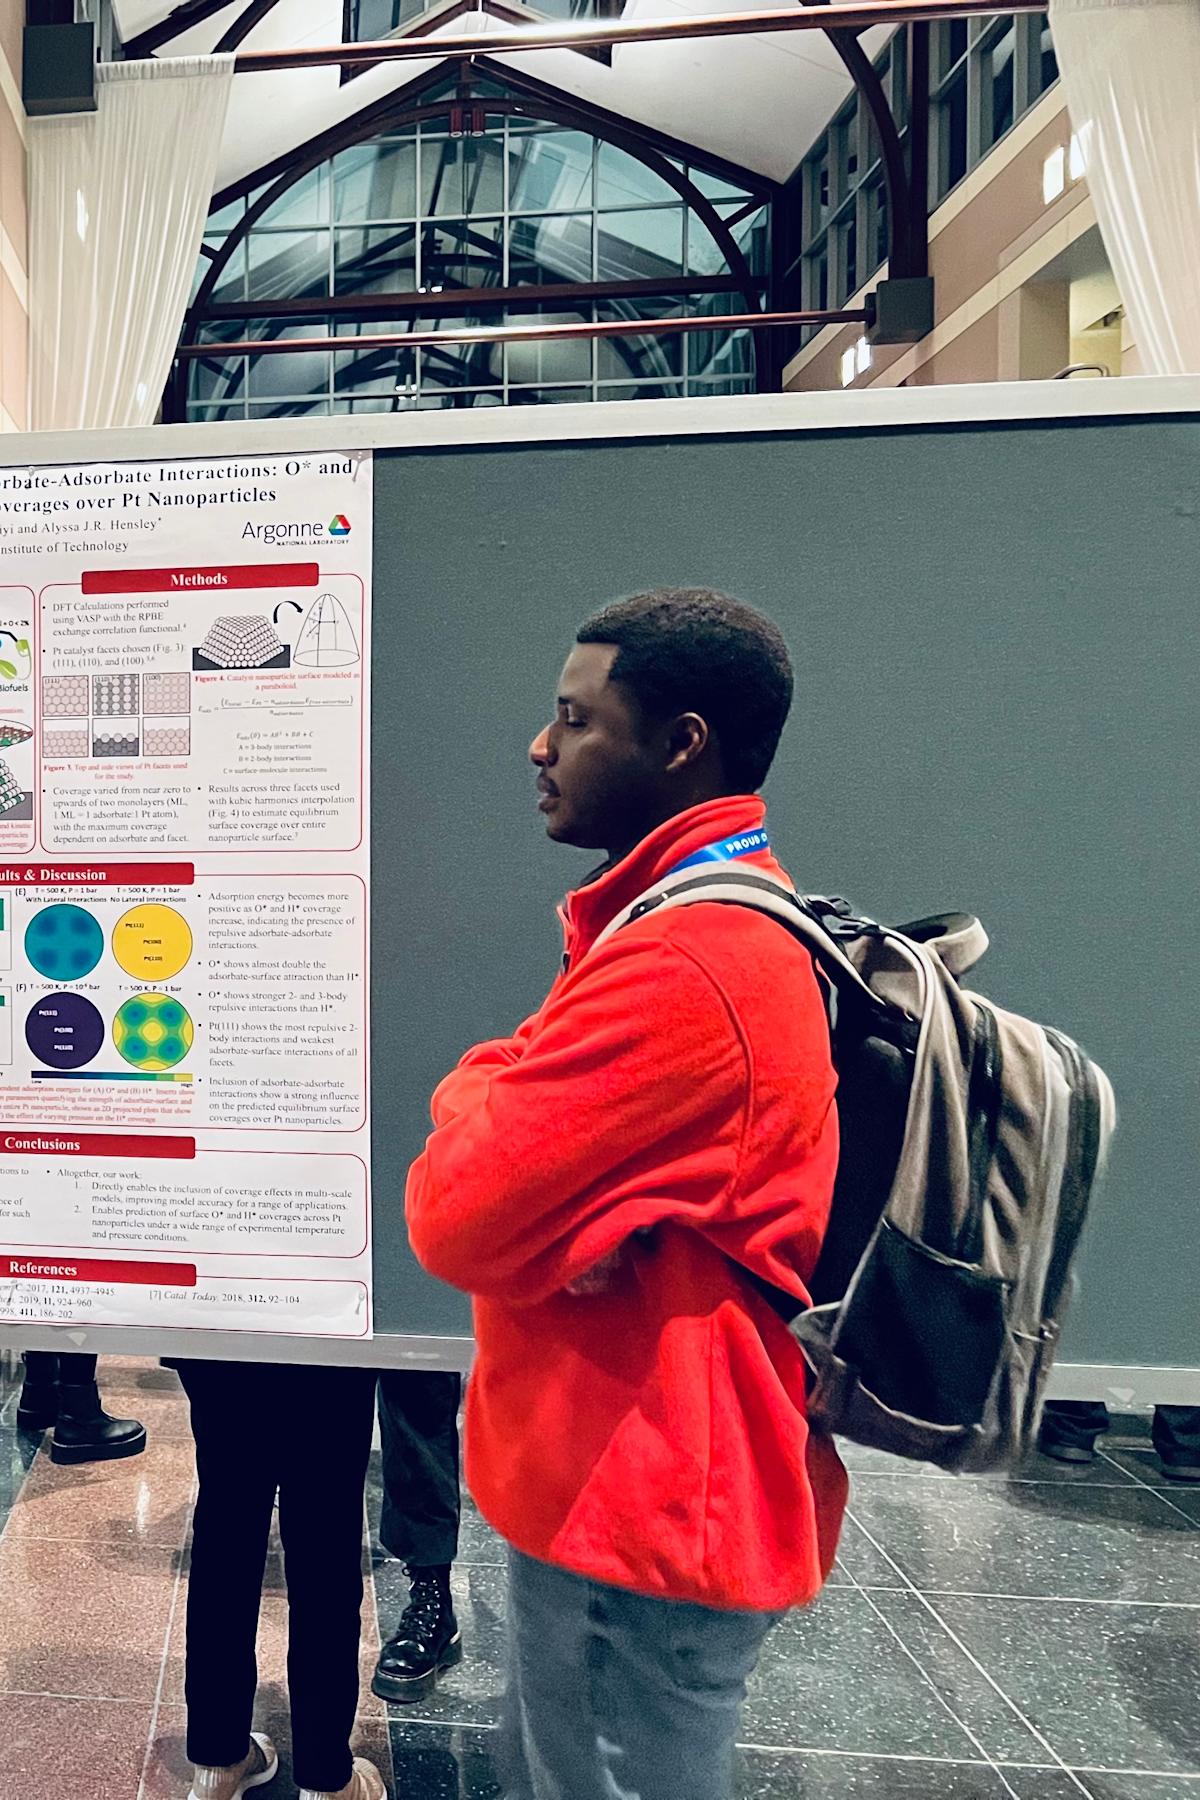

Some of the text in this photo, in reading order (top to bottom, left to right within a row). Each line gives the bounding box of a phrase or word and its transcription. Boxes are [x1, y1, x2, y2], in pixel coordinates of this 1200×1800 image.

[159, 464, 276, 481] Interactions:
[318, 458, 354, 474] and
[76, 497, 115, 510] over
[122, 492, 141, 507] Pt
[147, 486, 276, 508] Nanoparticles
[17, 522, 37, 534] and
[41, 521, 79, 535] Alyssa
[241, 521, 323, 544] Argonne
[46, 541, 60, 552] of
[62, 540, 128, 553] Technology
[170, 572, 228, 586] Methods
[52, 599, 169, 612] DFT Calculations performed
[52, 611, 163, 626] using VASP with the RPBE
[208, 783, 239, 793] Results
[269, 783, 291, 792] three
[293, 782, 318, 792] facets
[320, 782, 340, 791] used
[725, 834, 760, 853] PROUD
[23, 868, 36, 881] &
[39, 868, 106, 881] Discussion
[14, 887, 26, 897] (E)
[208, 891, 255, 902] Adsorption
[256, 894, 284, 903] energy
[287, 891, 325, 901] becomes
[15, 983, 27, 992] (F)
[4, 1136, 80, 1150] Conclusions
[9, 1260, 77, 1276] References
